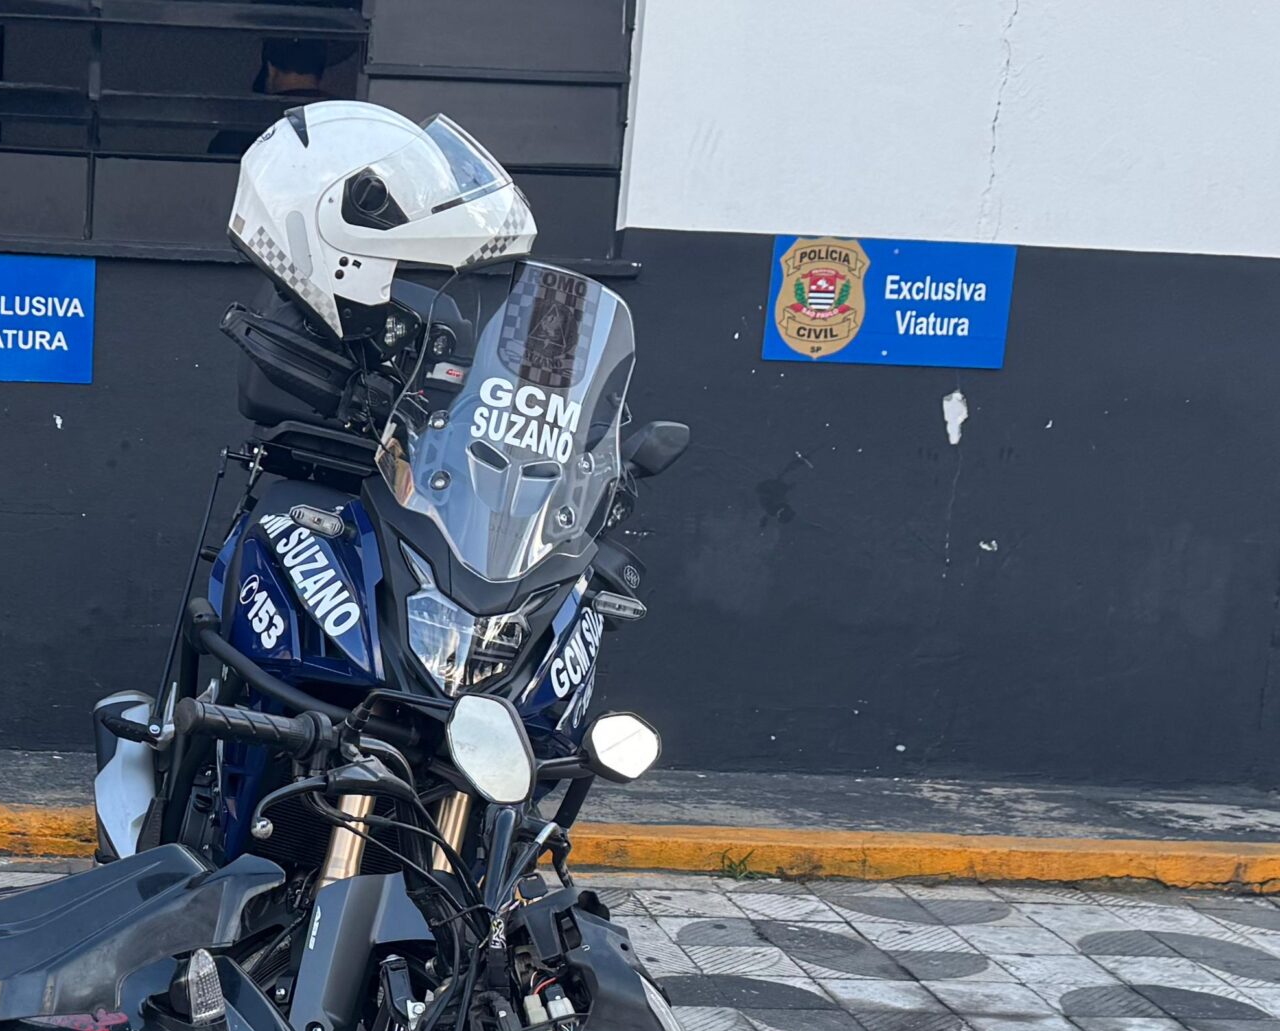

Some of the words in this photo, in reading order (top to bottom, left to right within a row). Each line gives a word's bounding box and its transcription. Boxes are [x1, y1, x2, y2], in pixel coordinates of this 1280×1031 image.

[799, 246, 851, 265] POLÍCIA
[884, 275, 987, 301] Exclusiva
[796, 326, 838, 339] CIVIL
[895, 310, 969, 336] Viatura
[479, 377, 582, 433] GCM
[470, 406, 574, 463] SUZANO
[276, 526, 361, 637] SUZANO
[247, 590, 285, 649] 153
[550, 632, 591, 698] GCM
